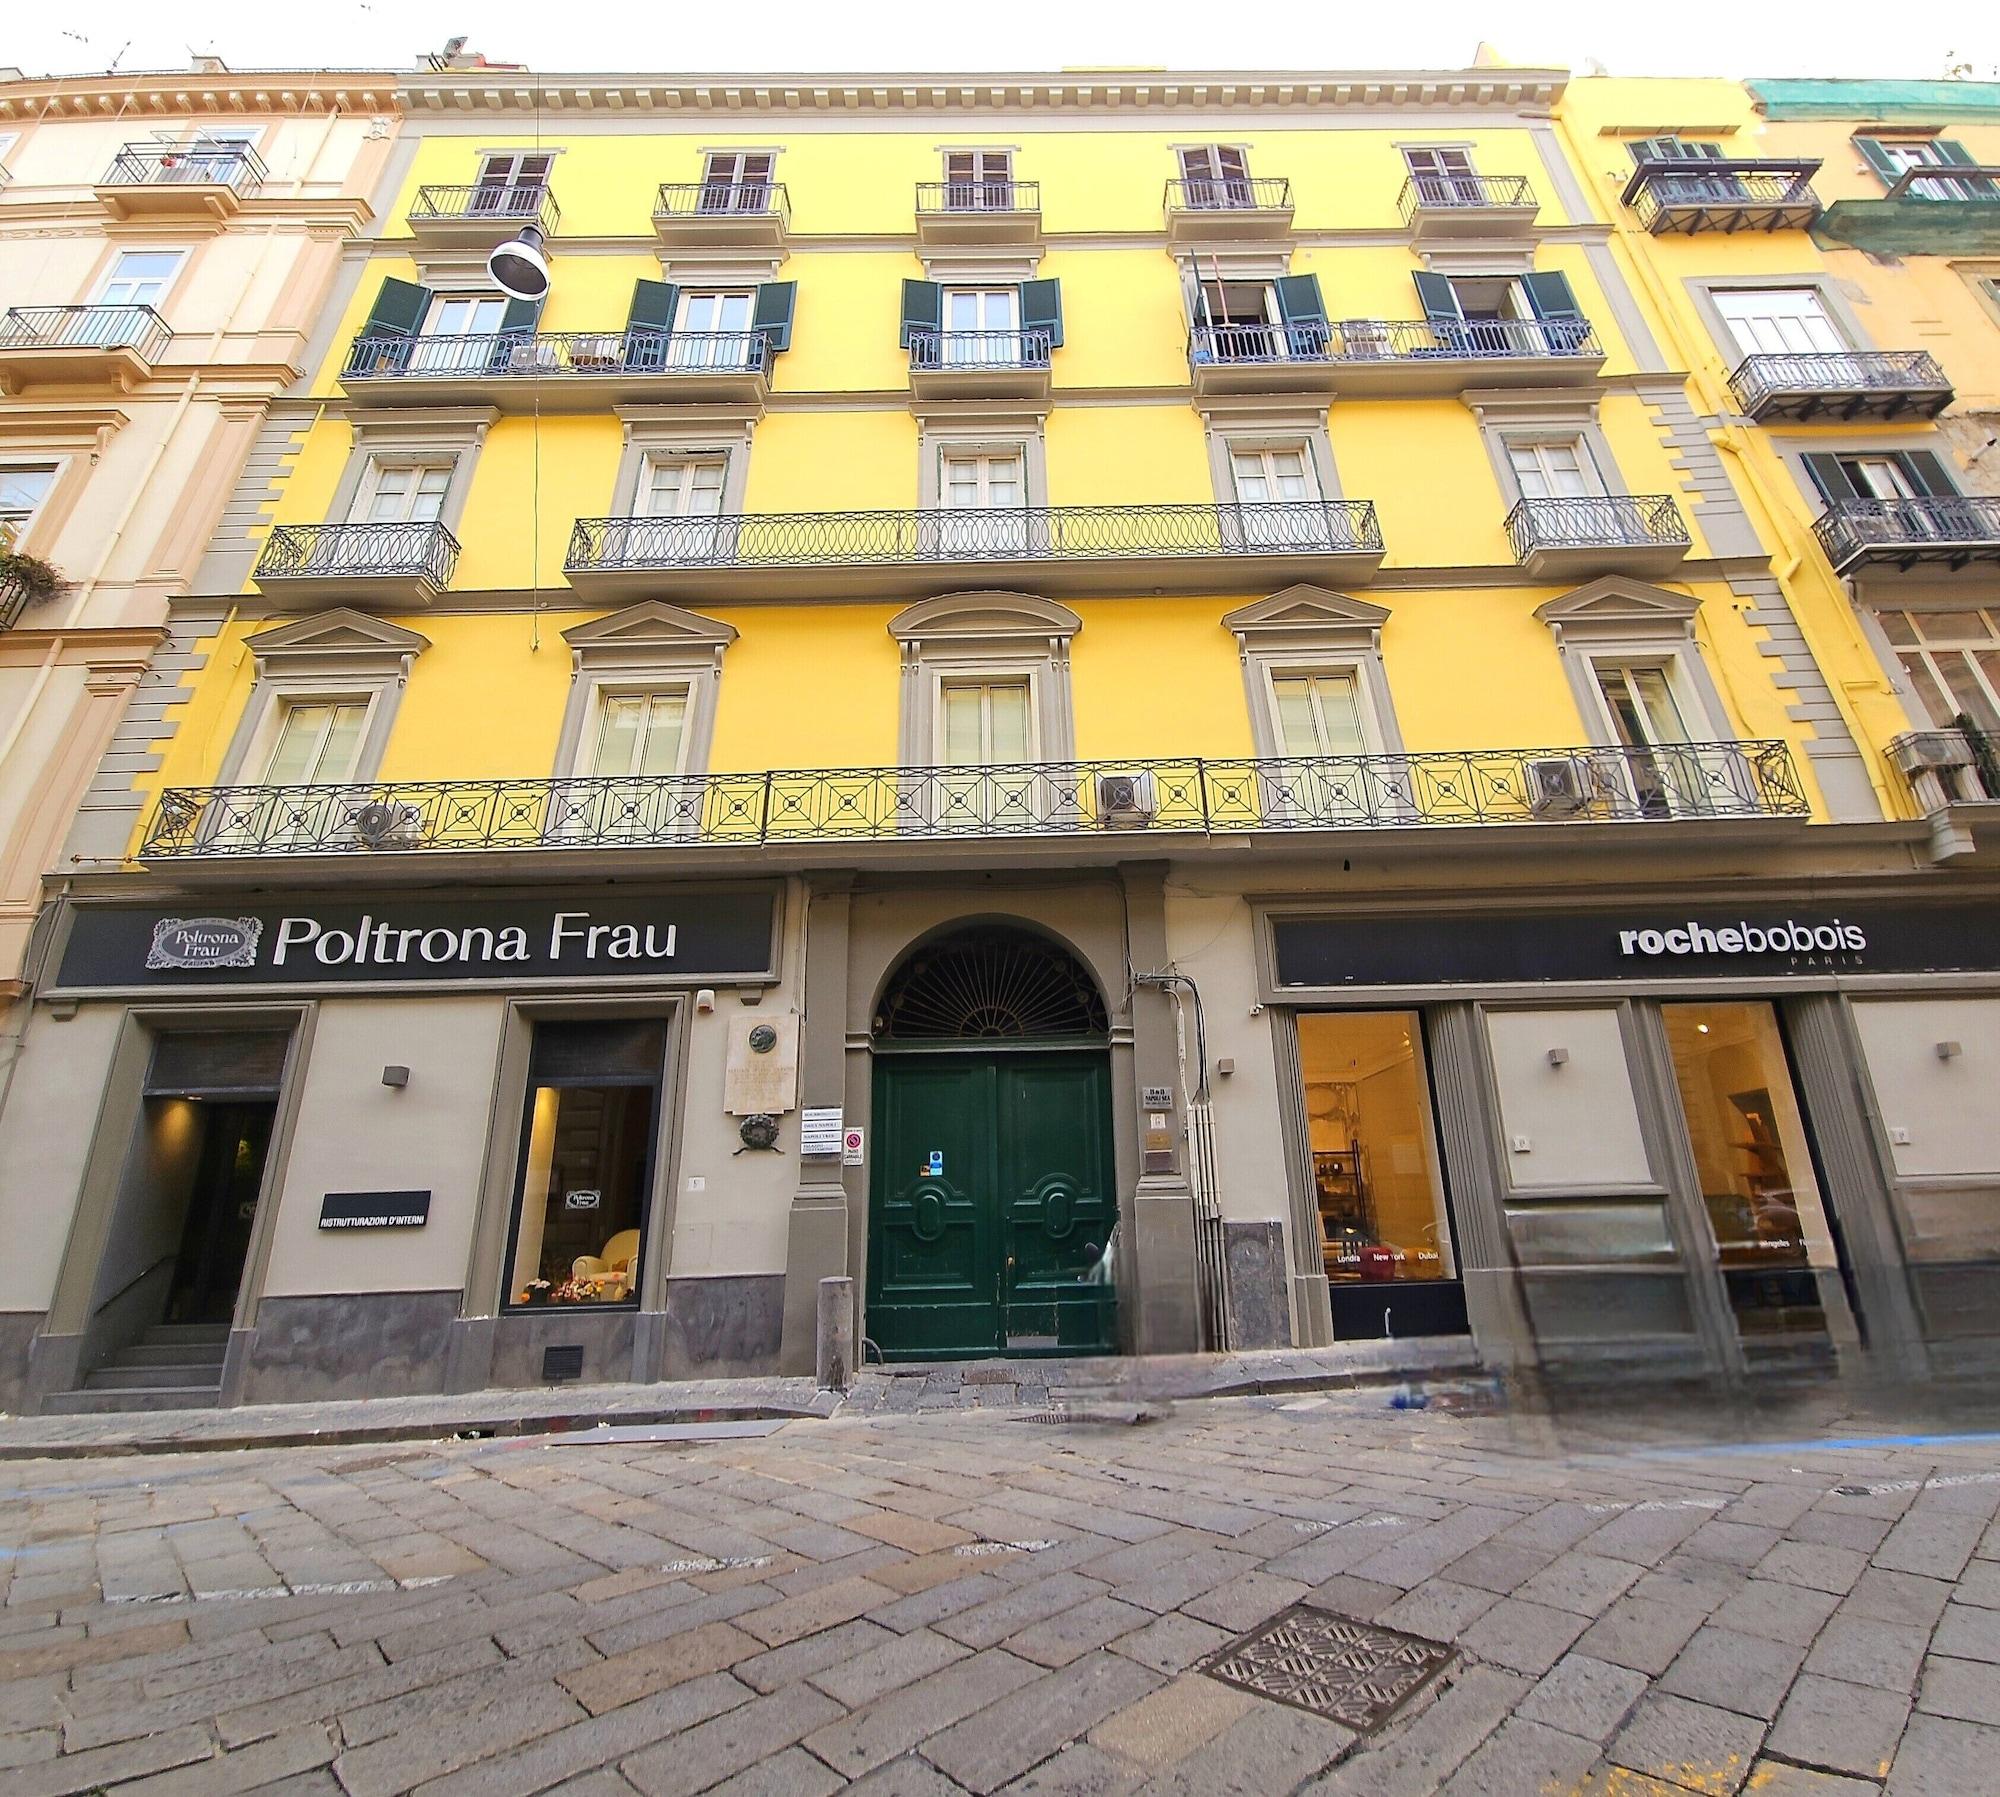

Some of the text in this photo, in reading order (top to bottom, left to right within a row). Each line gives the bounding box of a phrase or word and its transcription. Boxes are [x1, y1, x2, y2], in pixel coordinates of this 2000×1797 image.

[175, 929, 239, 944] Poltrona
[272, 912, 678, 966] Poltrona Frau
[1619, 918, 1867, 955] rochebobois
[183, 943, 220, 957] Frau
[320, 1215, 425, 1228] RISTRUTTURAZIONI D'INTERNI
[1337, 1254, 1361, 1264] Londra
[1373, 1253, 1389, 1262] New
